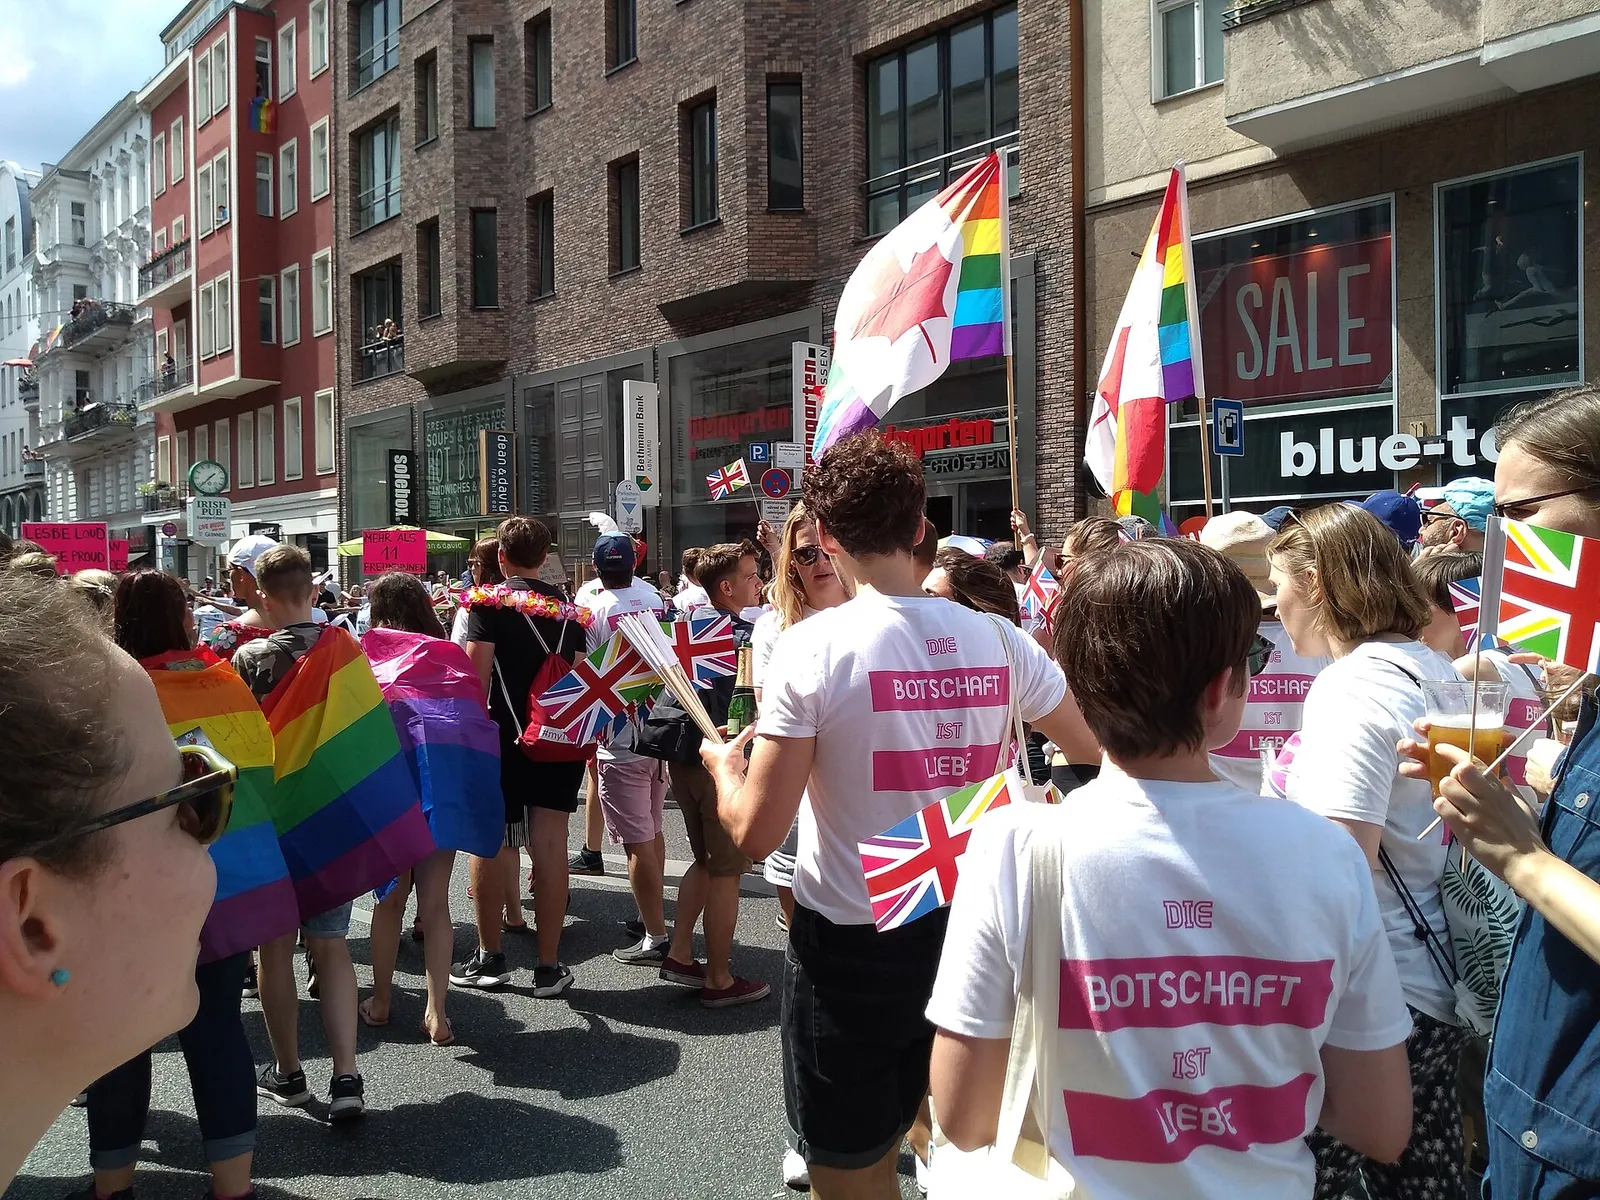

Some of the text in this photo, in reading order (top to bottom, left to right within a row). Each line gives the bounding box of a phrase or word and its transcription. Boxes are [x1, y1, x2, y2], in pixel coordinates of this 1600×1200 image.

[1236, 263, 1372, 380] SALE
[426, 420, 449, 431] FRESH
[688, 405, 790, 442] Weingarten
[426, 430, 454, 447] SOUPS
[636, 394, 645, 472] Bethmann Bank
[752, 446, 763, 460] P
[427, 447, 451, 484] HOT
[394, 454, 411, 517] solebox
[197, 501, 227, 509] IRISH
[201, 508, 223, 516] PUB
[24, 527, 106, 540] LESBE LOUD
[364, 533, 416, 544] MEHR ALS
[71, 551, 105, 563] PROUD
[381, 546, 399, 560] 11
[926, 637, 957, 656] DIE
[893, 674, 1000, 700] BOTSCHAFT
[1251, 680, 1313, 694] TSCHAF
[1264, 712, 1282, 724] IST
[936, 722, 963, 739] IST
[1250, 736, 1285, 751] LIEB
[924, 752, 972, 778] LIEBE
[1163, 900, 1213, 929] DIE
[1085, 970, 1301, 1012] BOTSCHAFT
[1172, 1046, 1211, 1080] IST
[1155, 1098, 1237, 1144] LIEBE
